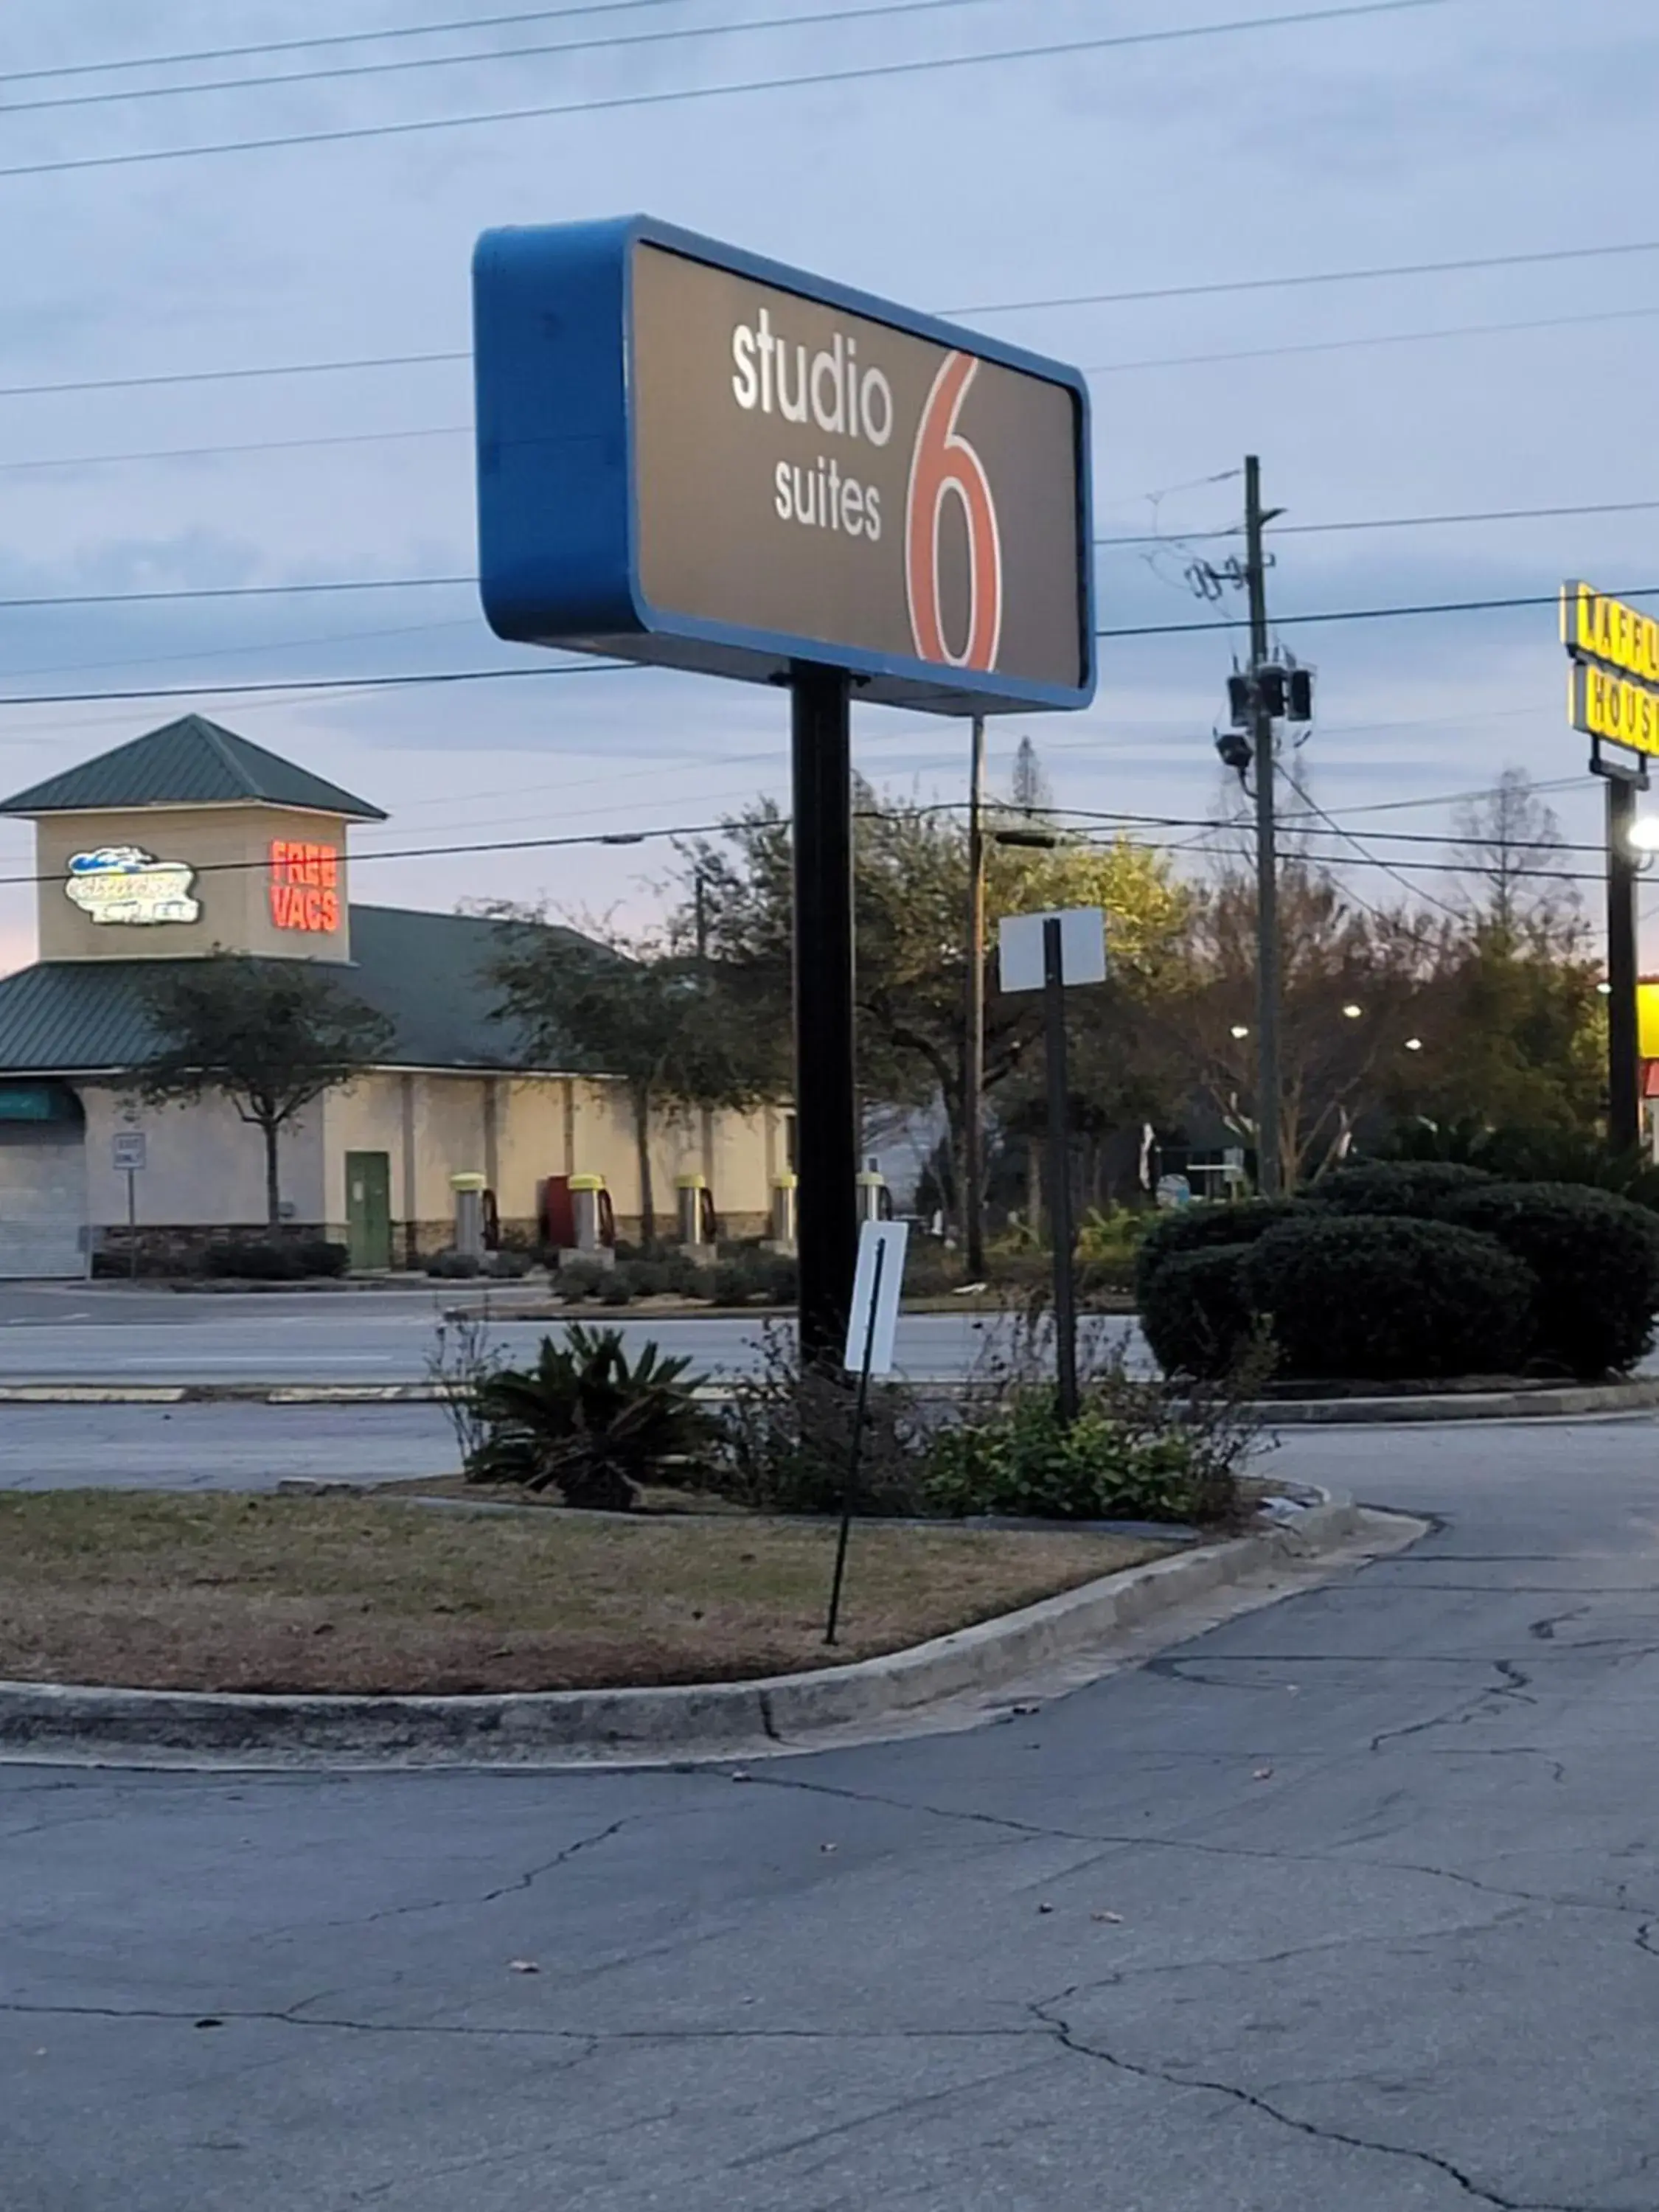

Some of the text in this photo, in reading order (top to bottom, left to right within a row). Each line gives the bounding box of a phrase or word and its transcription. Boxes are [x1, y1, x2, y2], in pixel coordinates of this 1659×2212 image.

[732, 308, 893, 446] studio
[775, 456, 881, 541] suites
[905, 350, 1002, 672] 6
[1594, 672, 1659, 747] HOUS
[271, 841, 337, 888] FREE
[270, 886, 338, 931] VACS
